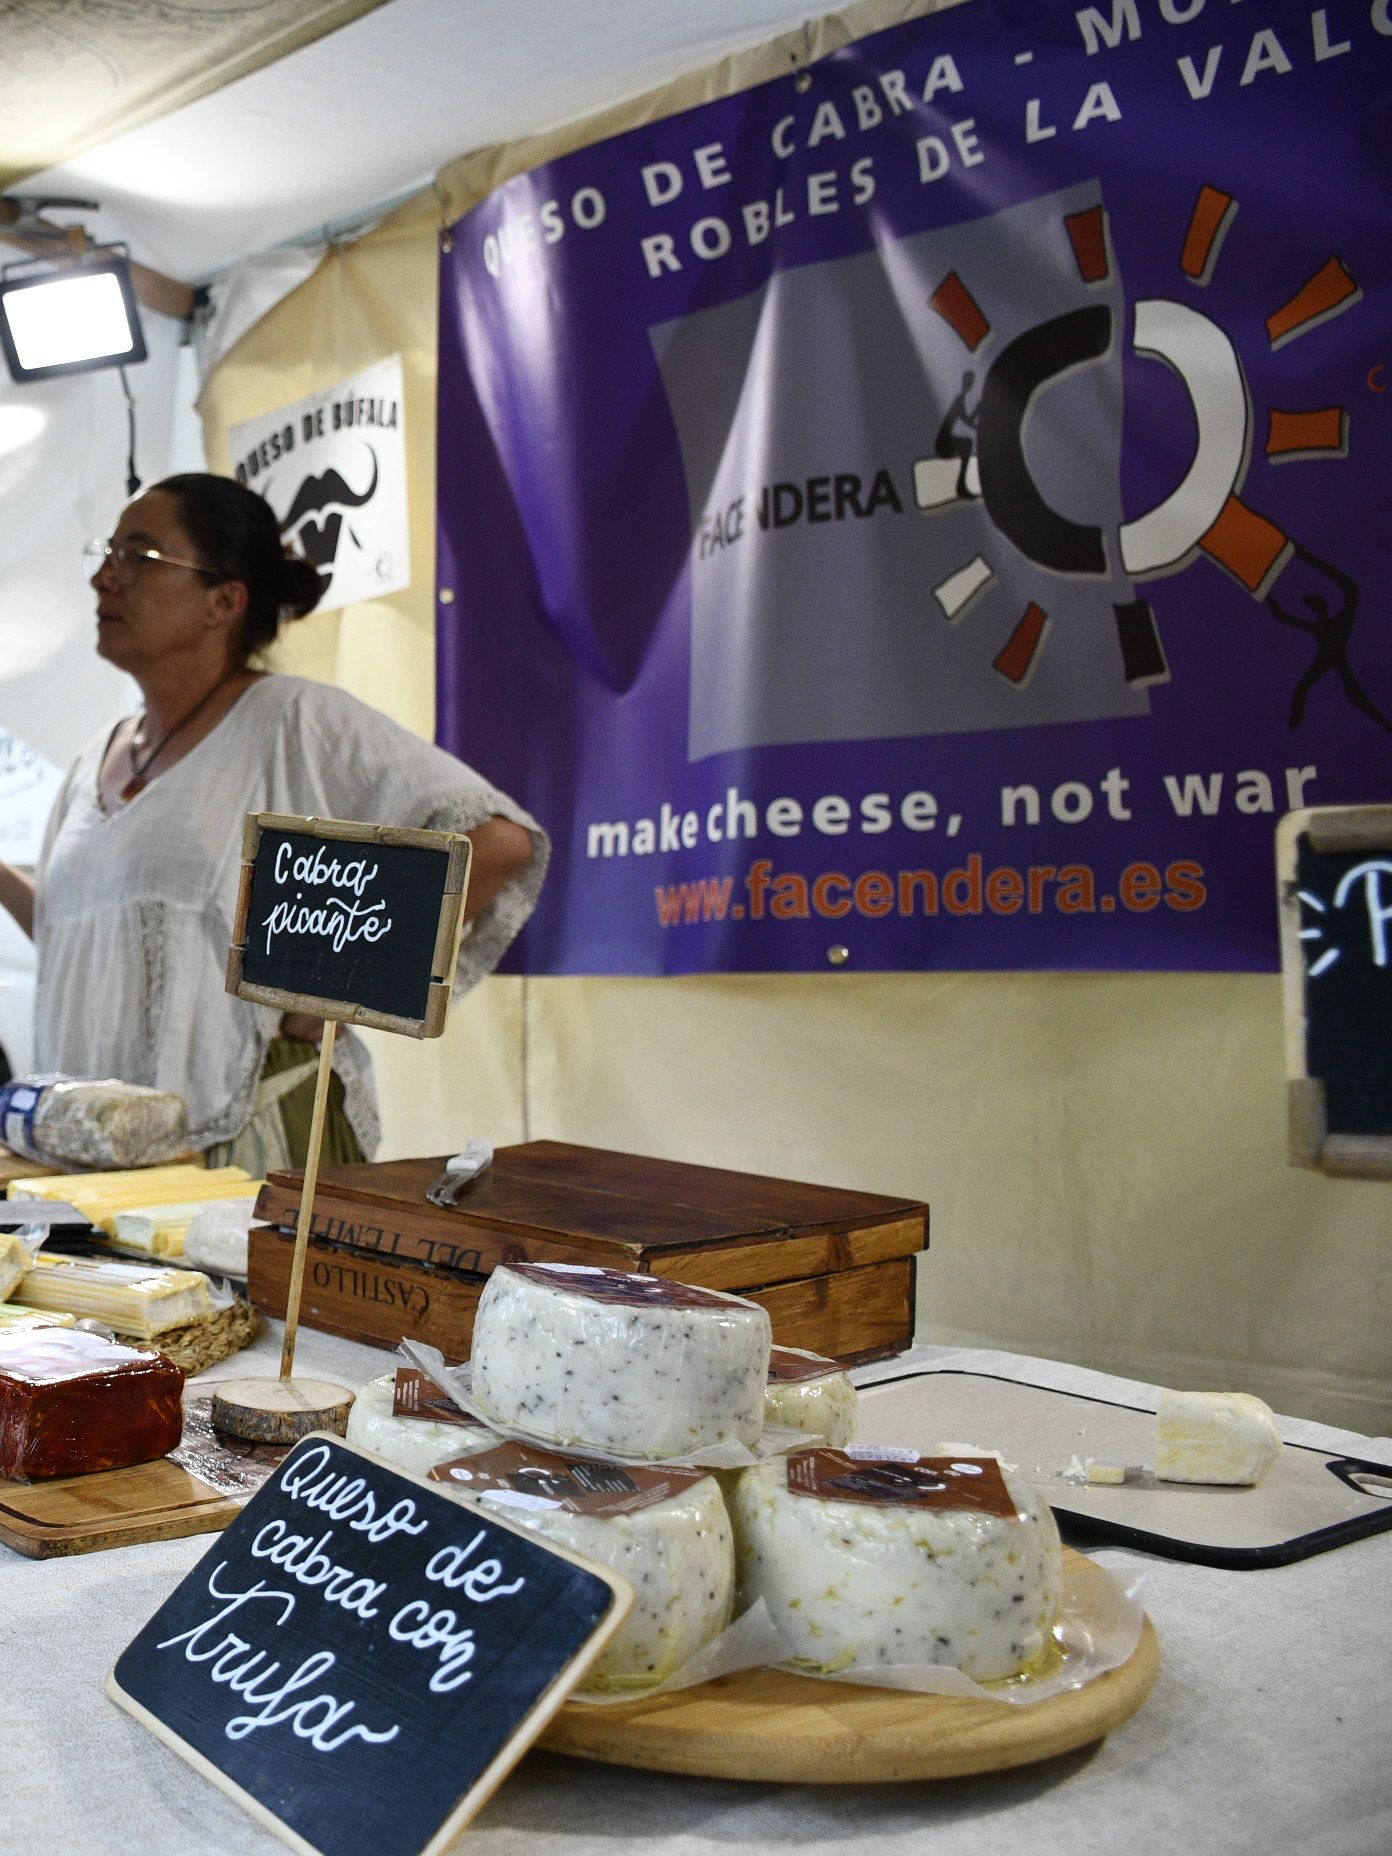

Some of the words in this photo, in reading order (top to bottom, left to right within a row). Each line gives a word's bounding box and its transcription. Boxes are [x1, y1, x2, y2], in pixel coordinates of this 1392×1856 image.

[485, 187, 606, 278] QUESO
[641, 143, 732, 209] DE
[771, 53, 964, 161] CABRA
[641, 157, 876, 278] ROBLES
[917, 119, 986, 186] DE
[1023, 81, 1123, 145] LA
[235, 424, 294, 484] QUESO
[302, 409, 325, 443] DE
[698, 469, 902, 559] FACENDERA
[586, 802, 699, 859] make
[707, 787, 964, 844] cheese,
[1001, 767, 1130, 826] not
[1163, 762, 1318, 821] war
[274, 842, 378, 896] Cabra
[653, 854, 1208, 927] www.facendera.es
[262, 892, 392, 955] picante
[313, 1261, 431, 1318] CASTILLO
[280, 1445, 429, 1544] Queso
[425, 1530, 526, 1602] de
[251, 1519, 378, 1616] cabra
[388, 1599, 475, 1692] con
[156, 1560, 399, 1752] Trufa
